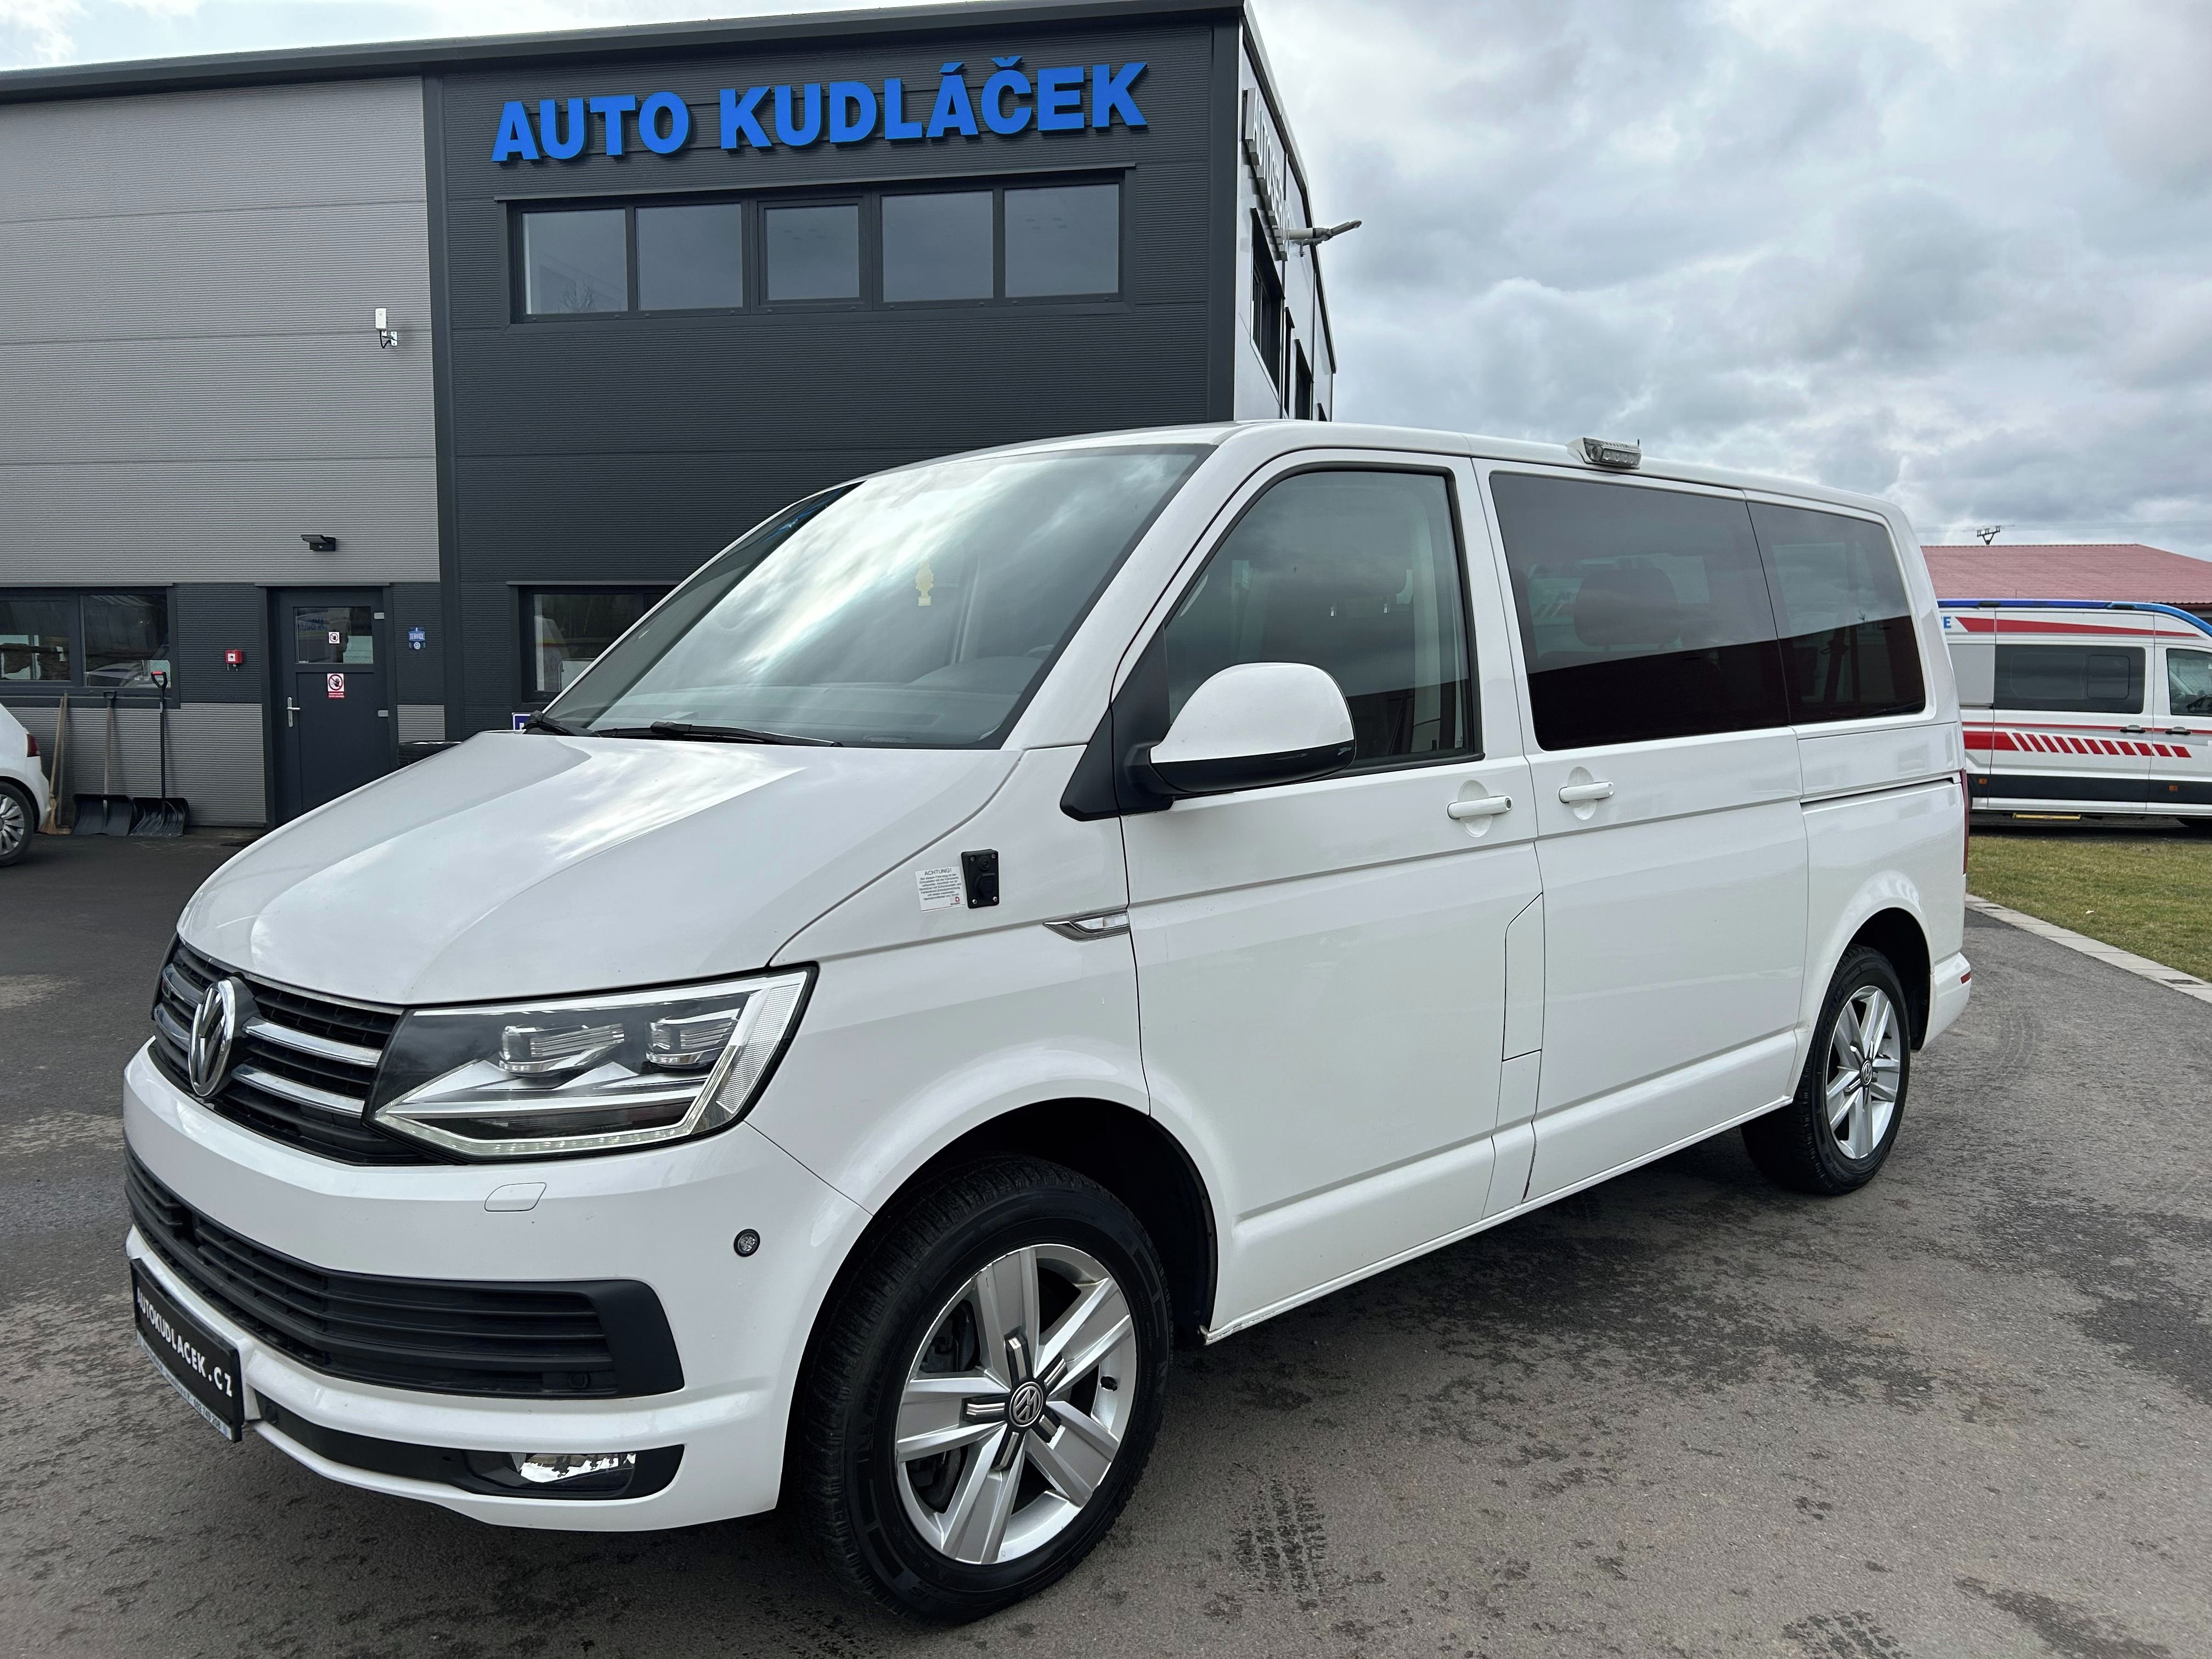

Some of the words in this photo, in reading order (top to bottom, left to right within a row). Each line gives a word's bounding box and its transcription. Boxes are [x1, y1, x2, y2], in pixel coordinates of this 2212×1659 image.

[492, 91, 690, 163] AUTO
[719, 55, 1148, 150] KUDLÁČEK
[138, 1287, 233, 1397] AUTOKUDLACEK.CZ
